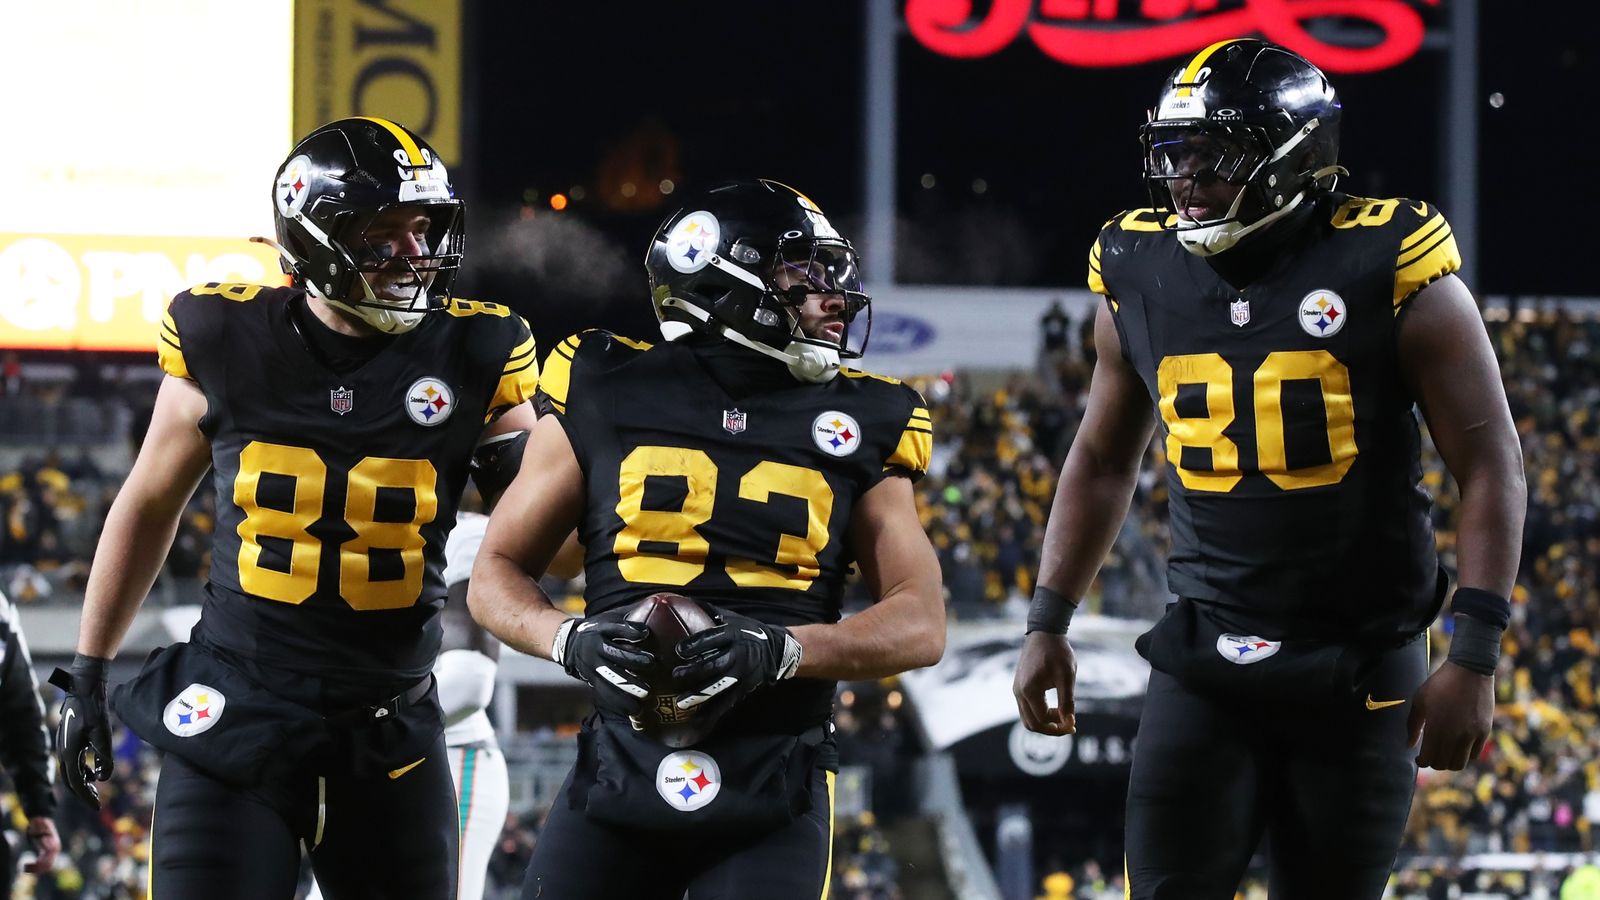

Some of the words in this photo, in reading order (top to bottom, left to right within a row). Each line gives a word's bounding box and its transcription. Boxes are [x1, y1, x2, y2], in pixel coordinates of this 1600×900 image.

[1302, 309, 1322, 317] Steelers
[332, 398, 350, 410] NFL
[1157, 350, 1359, 493] 80
[233, 440, 438, 611] 88
[613, 445, 834, 592] 83
[664, 776, 686, 784] Steelers
